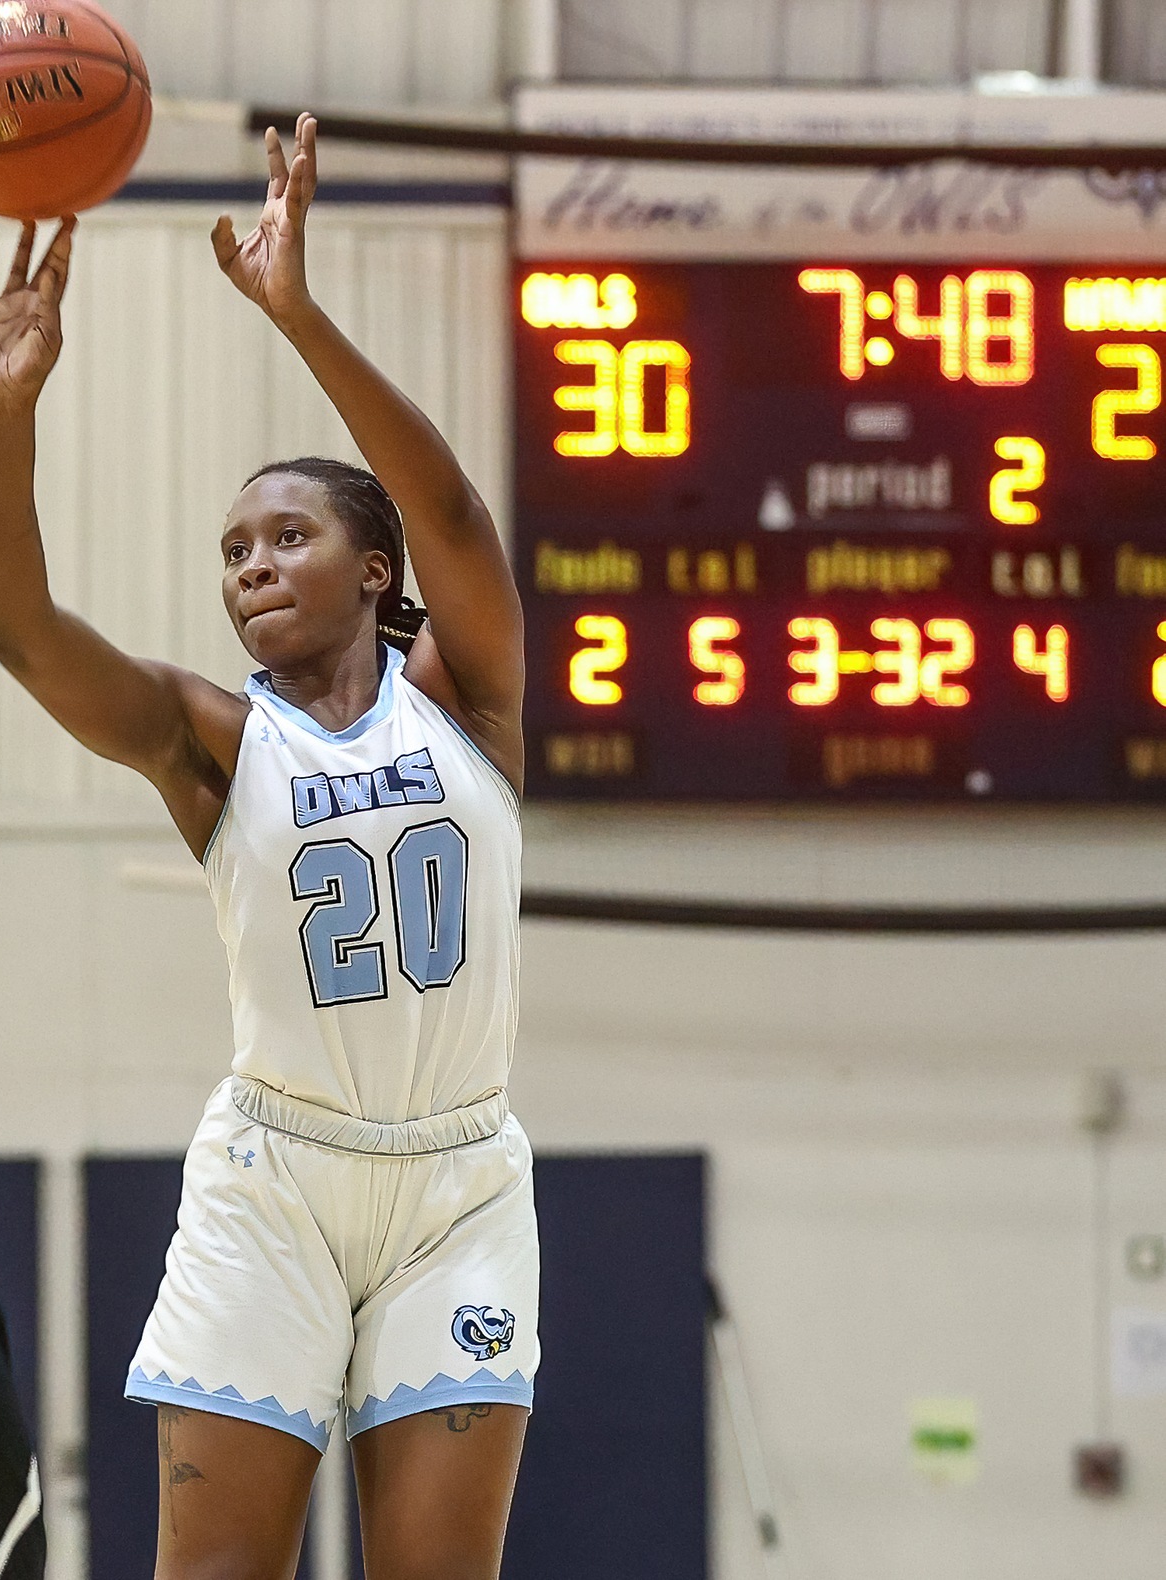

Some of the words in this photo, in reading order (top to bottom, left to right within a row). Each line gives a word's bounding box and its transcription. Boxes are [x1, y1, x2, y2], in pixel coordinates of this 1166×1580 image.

[798, 269, 1034, 385] 7:48
[554, 340, 691, 457] 30
[1092, 343, 1161, 459] 2
[989, 436, 1046, 525] 2
[570, 615, 627, 705] 2
[688, 617, 745, 706] 5
[787, 617, 975, 706] 3-32
[1012, 625, 1068, 702] 4
[291, 747, 446, 829] OWLS
[288, 817, 469, 1009] 20
